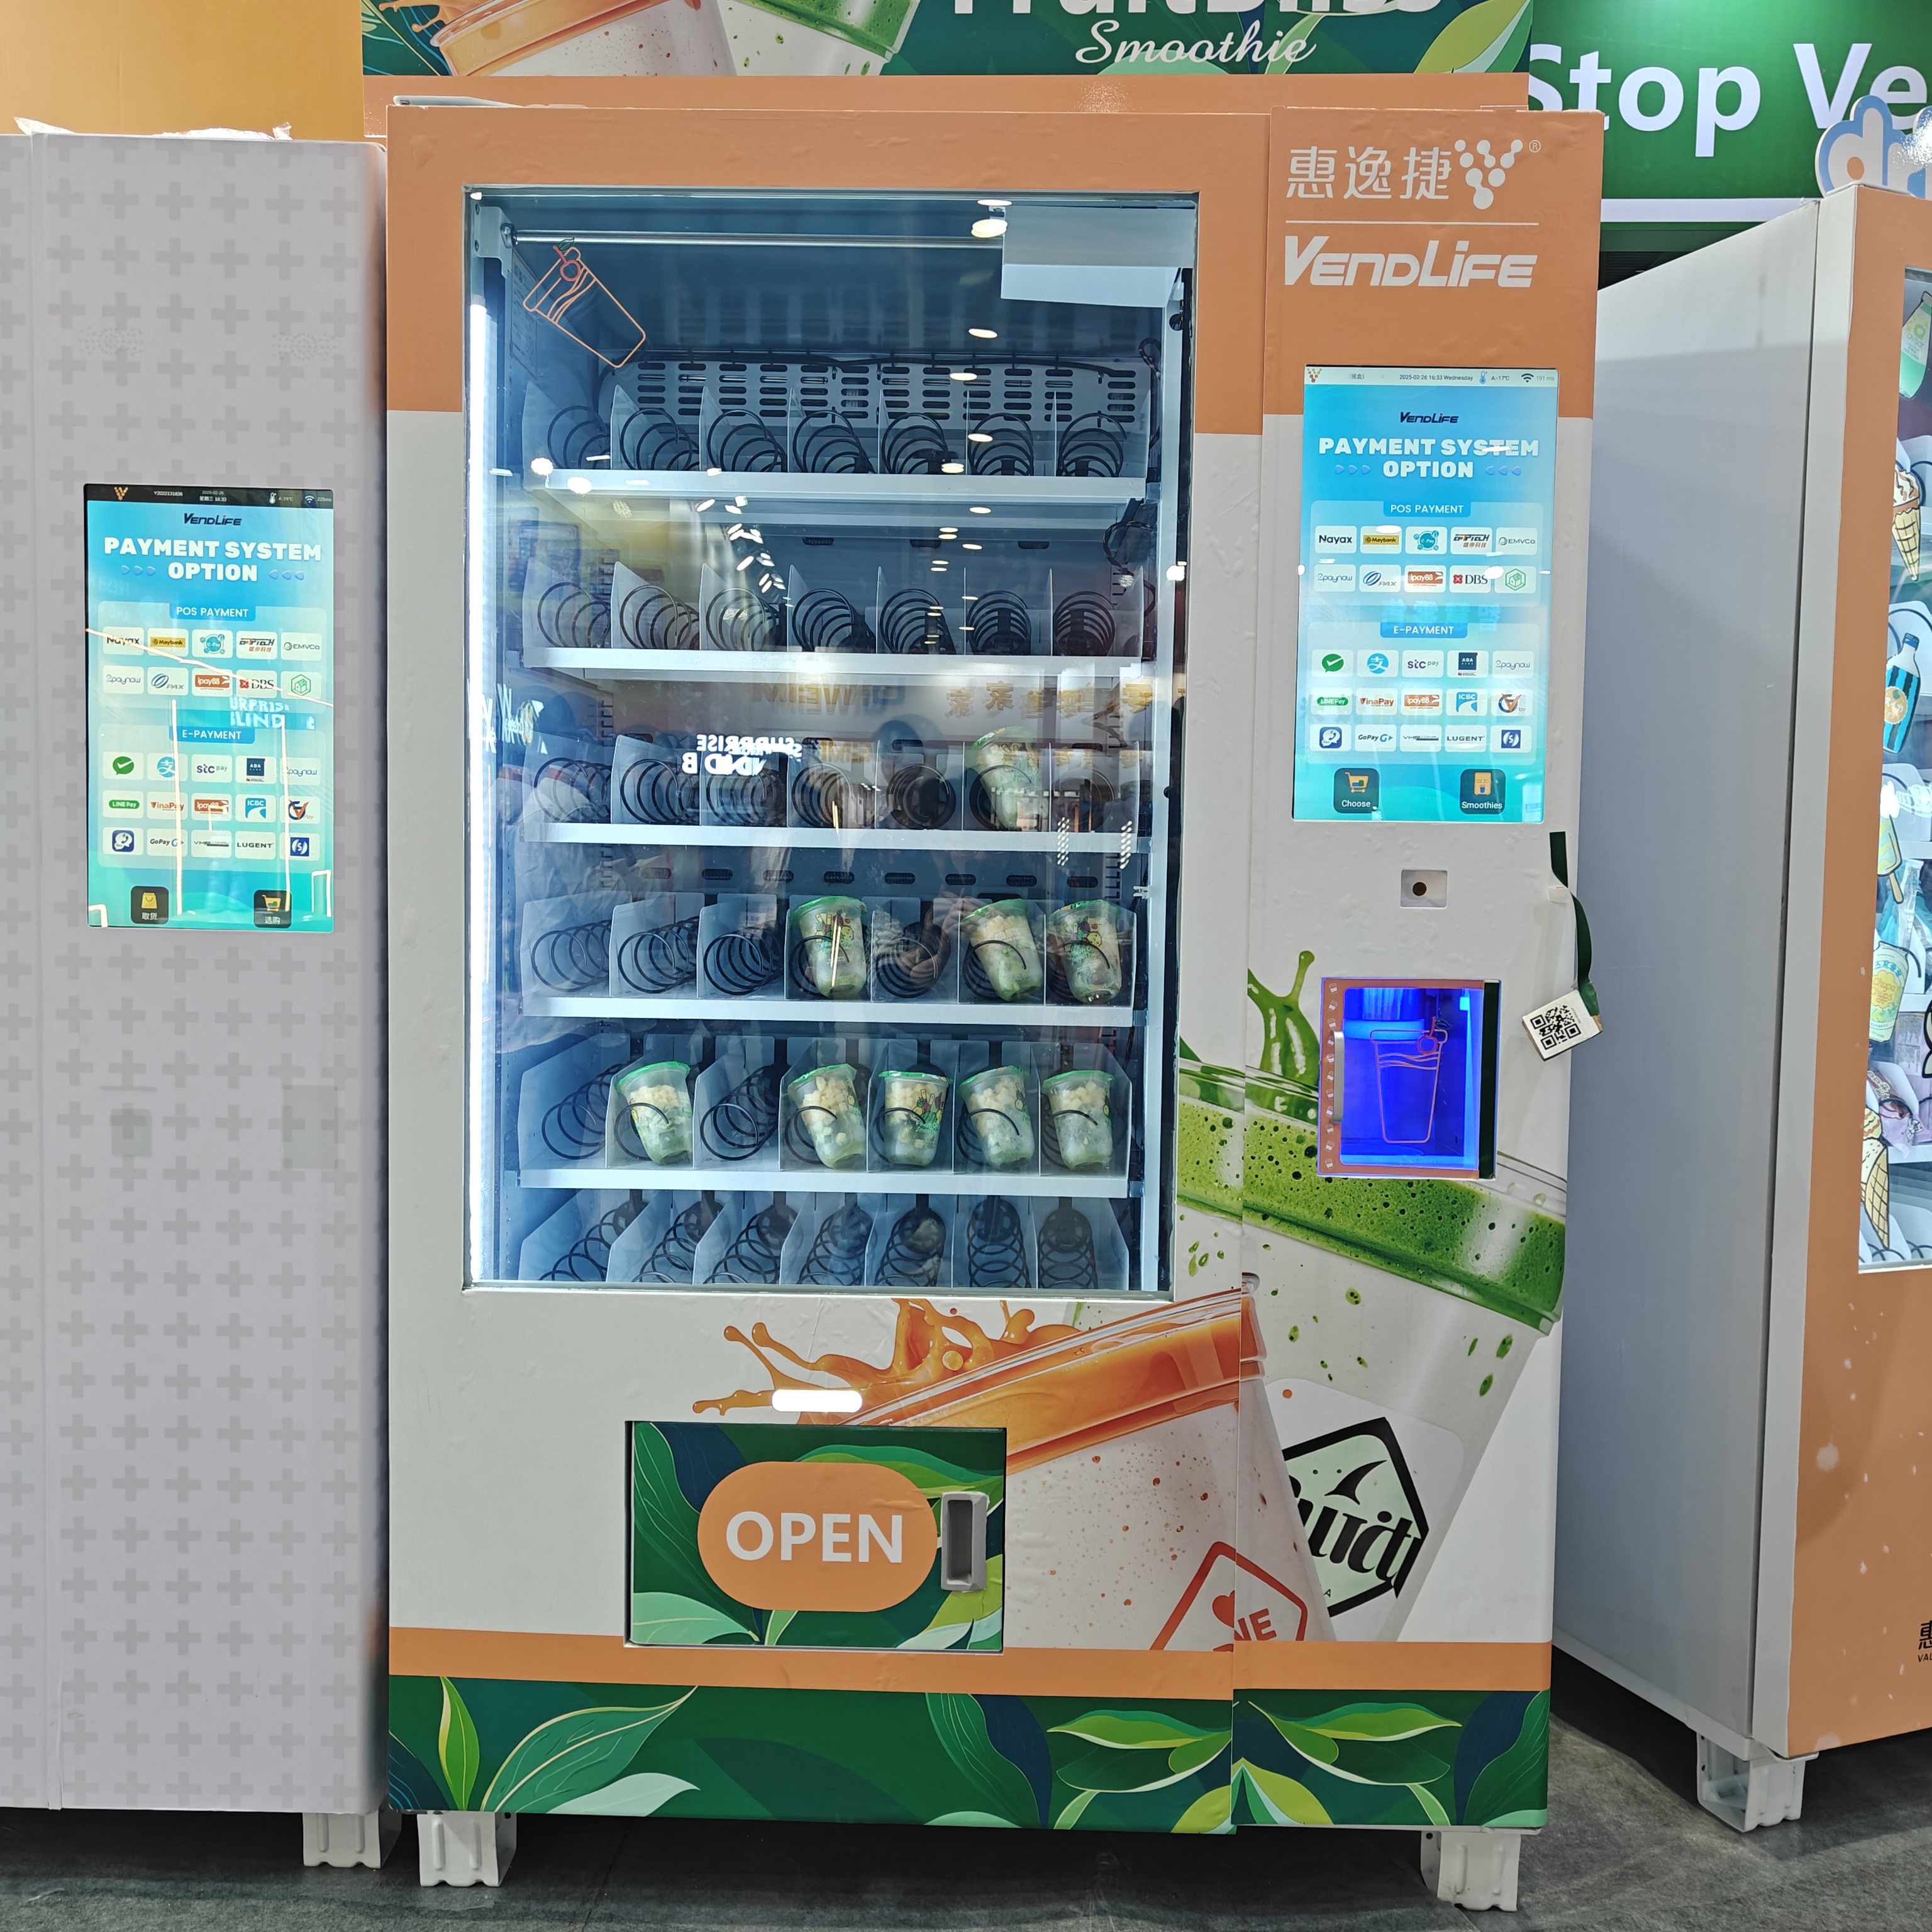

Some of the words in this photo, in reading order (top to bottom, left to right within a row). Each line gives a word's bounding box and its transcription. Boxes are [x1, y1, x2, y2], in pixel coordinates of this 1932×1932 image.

[1075, 18, 1318, 65] Smoothie
[1528, 43, 1760, 157] Stop
[1286, 146, 1452, 199] 惠逸捷
[1319, 438, 1435, 455] PAYMENT
[1441, 439, 1539, 456] SYSTEM
[1383, 461, 1474, 478] OPTION
[1391, 504, 1411, 514] POS
[1415, 505, 1464, 514] PAYMENT
[1319, 535, 1352, 545] Nayax
[104, 537, 219, 558] PAYMENT
[225, 541, 321, 561] SYSTEM
[168, 562, 257, 582] OPTION
[1411, 573, 1433, 582] ipay88
[1465, 574, 1488, 584] DBS
[176, 607, 197, 616] POS
[201, 608, 248, 618] PAYMENT
[1394, 625, 1454, 635] E-PAYMENT
[1407, 659, 1426, 669] stc
[197, 677, 220, 686] ipay88
[251, 679, 274, 689] DBS
[1360, 697, 1394, 706] VinaPay
[1407, 697, 1430, 705] ipay88
[182, 730, 242, 740] E-PAYMENT
[197, 763, 215, 774] stc
[1341, 799, 1371, 808] Choose
[1462, 801, 1502, 809] Smoothies
[265, 916, 280, 924] 选购
[726, 1511, 902, 1563] OPEN
